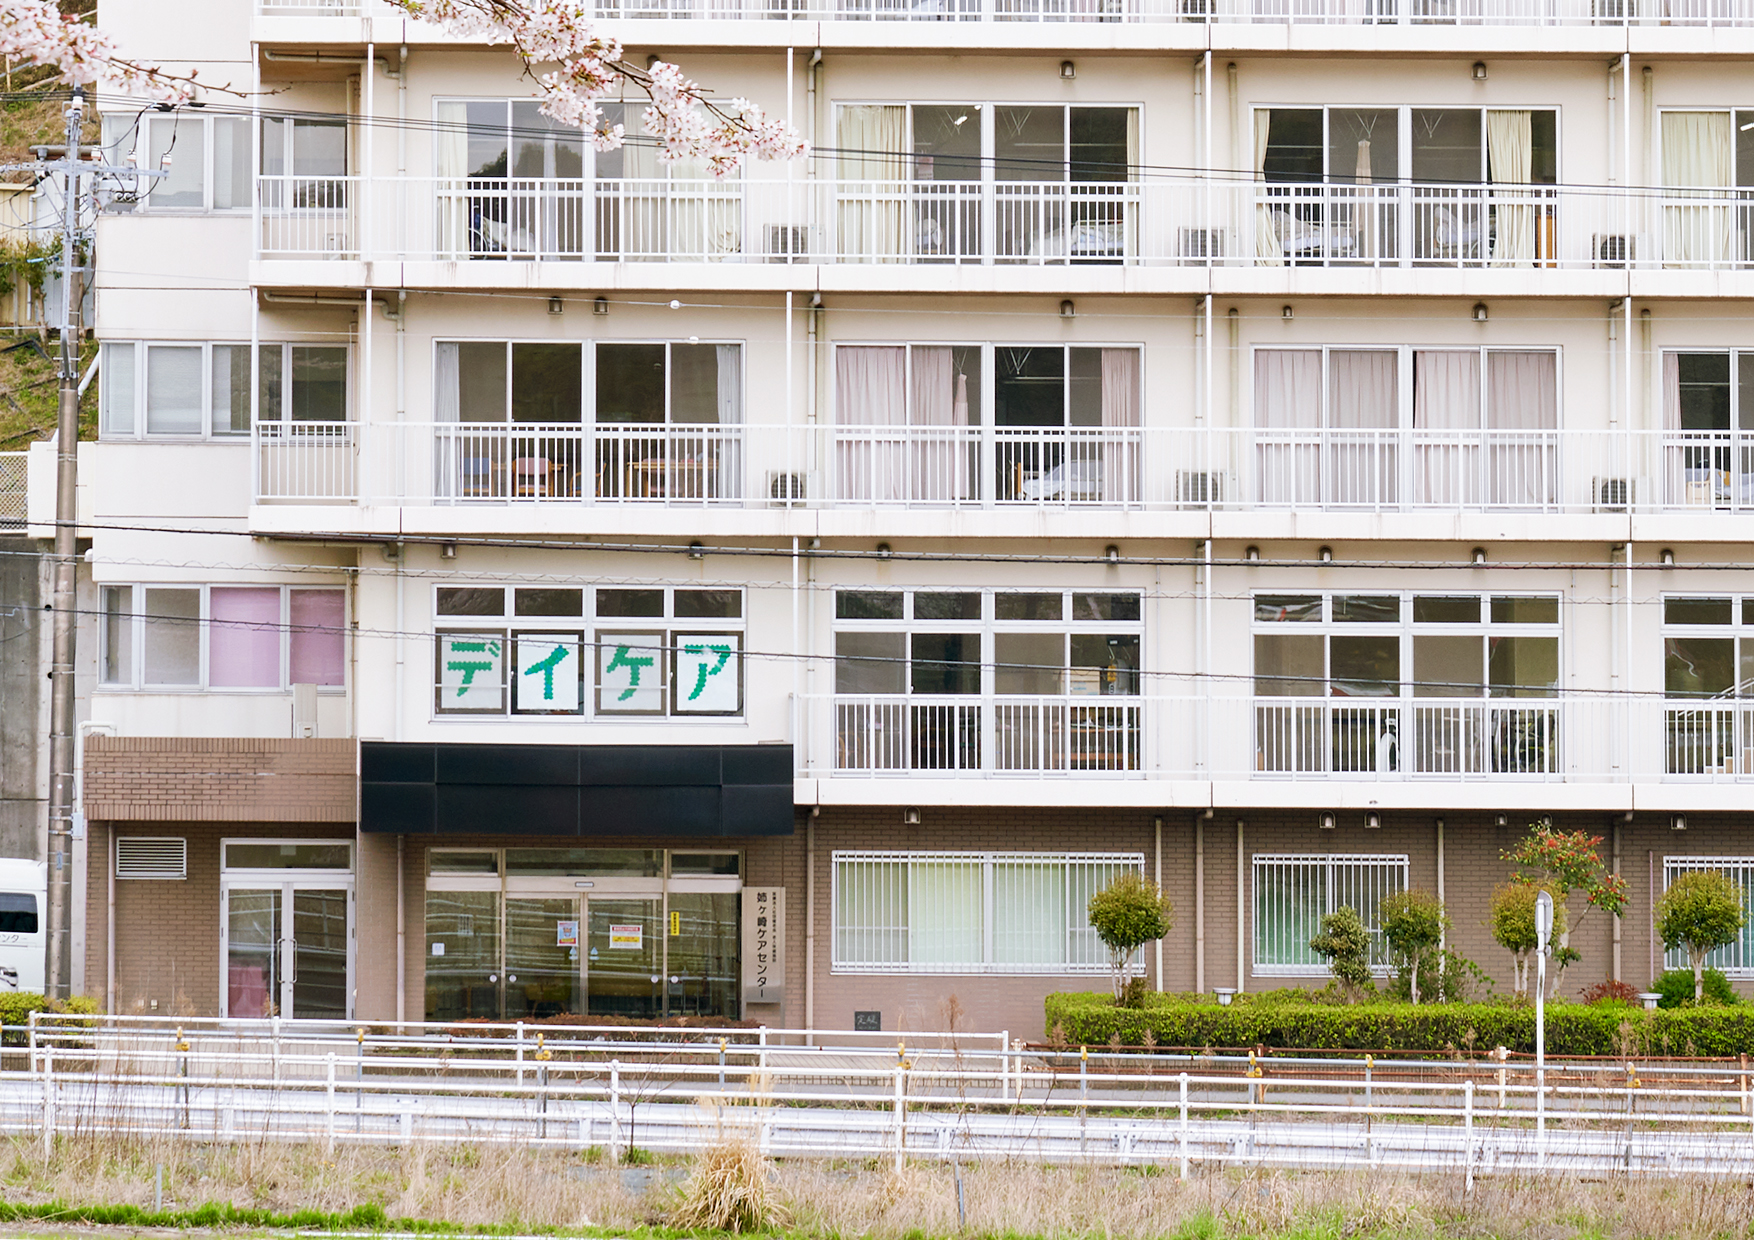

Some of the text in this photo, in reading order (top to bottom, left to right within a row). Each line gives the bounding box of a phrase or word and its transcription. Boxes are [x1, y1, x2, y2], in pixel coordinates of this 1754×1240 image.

[446, 640, 732, 702] デイケア
[0, 933, 28, 944] ンター
